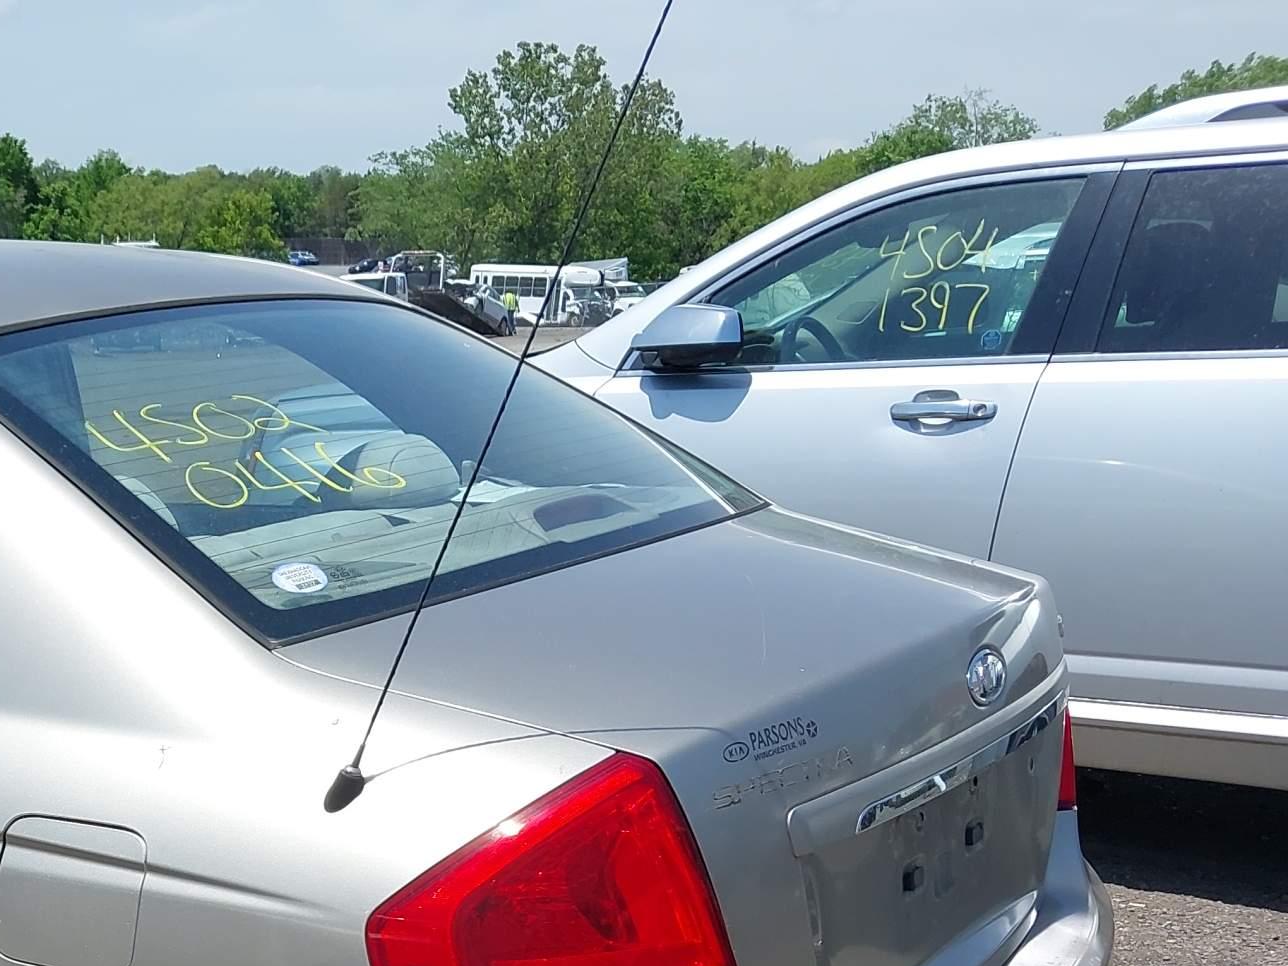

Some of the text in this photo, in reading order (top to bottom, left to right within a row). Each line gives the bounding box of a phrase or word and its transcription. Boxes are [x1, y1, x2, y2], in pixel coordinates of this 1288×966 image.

[880, 219, 999, 281] 4504
[879, 281, 990, 334] 1397
[85, 395, 330, 463] 4502
[185, 442, 407, 509] 0416
[726, 716, 805, 760] KIA PARSONS
[713, 746, 853, 810] SPECTRA
